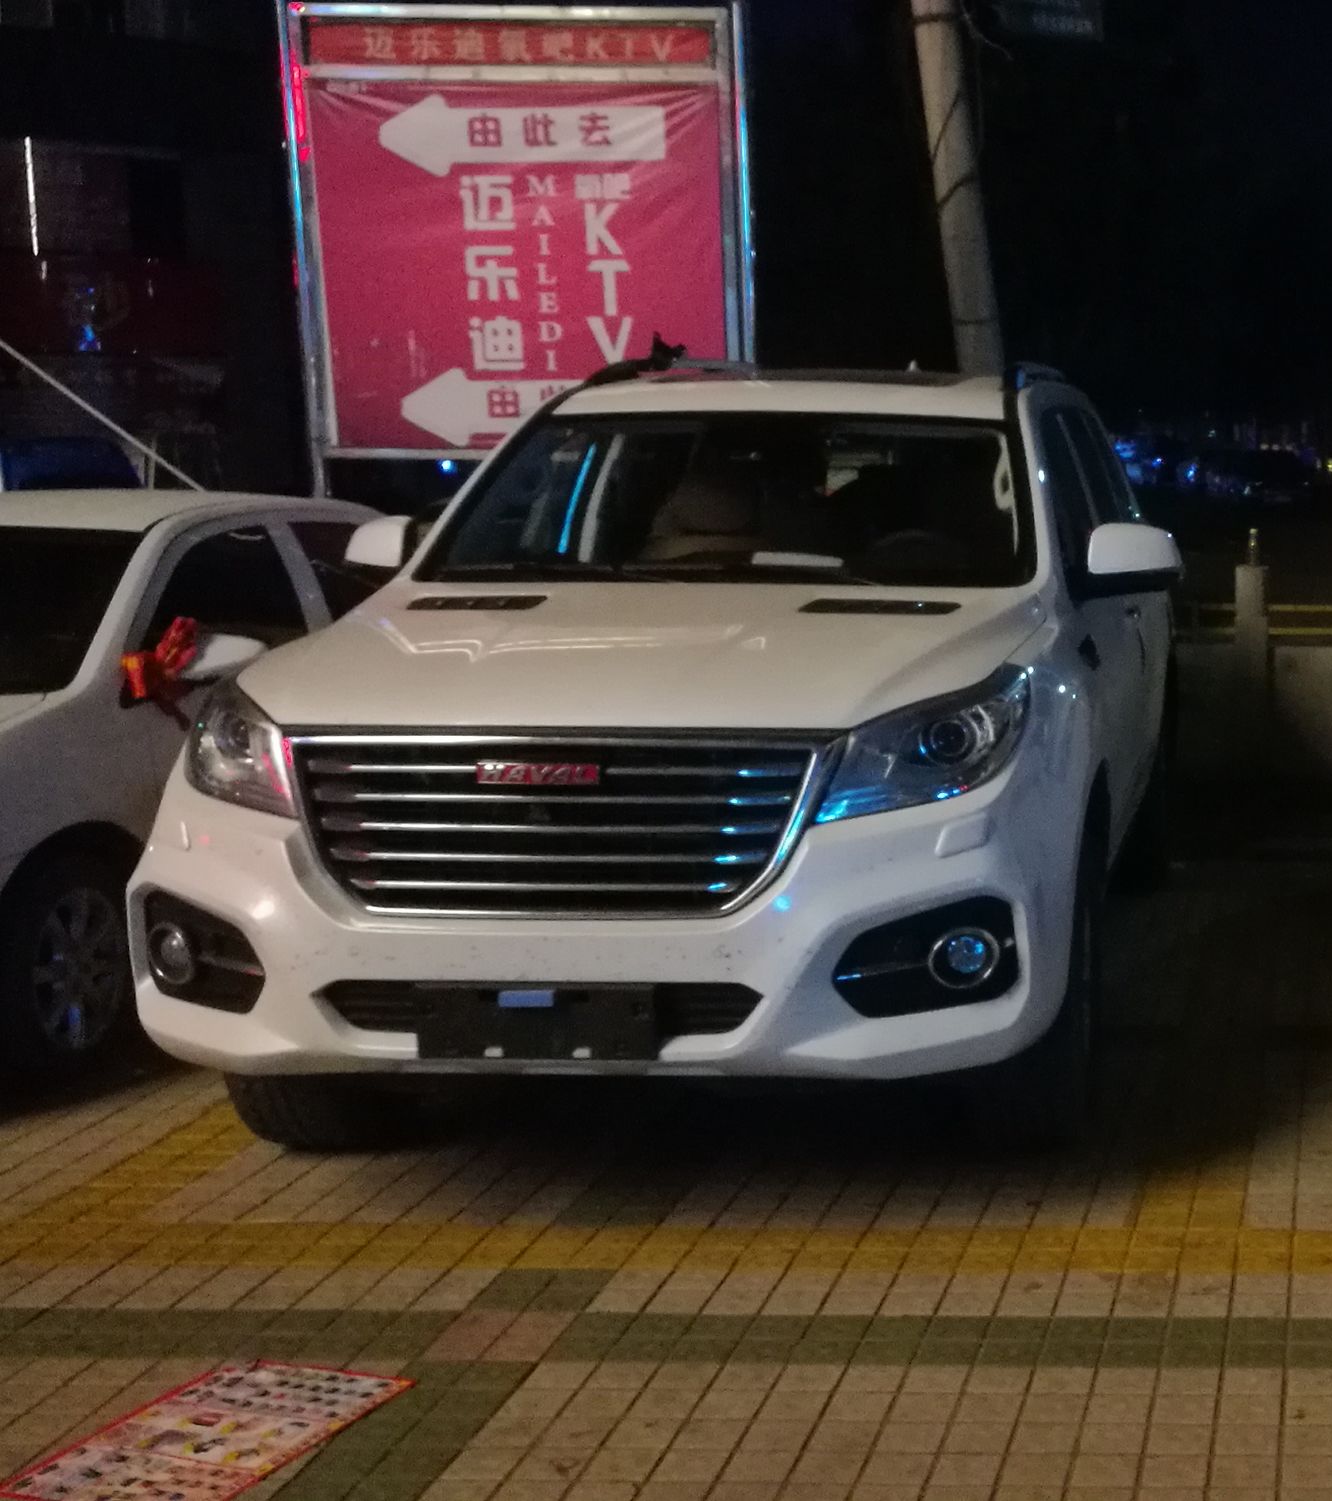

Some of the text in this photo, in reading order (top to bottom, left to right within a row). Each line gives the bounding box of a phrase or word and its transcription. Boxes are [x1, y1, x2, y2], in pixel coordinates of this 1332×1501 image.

[468, 113, 613, 147] 由此去
[460, 175, 526, 371] 迈乐迪
[526, 175, 564, 371] MAILEDI
[481, 763, 596, 784] HAVAL
